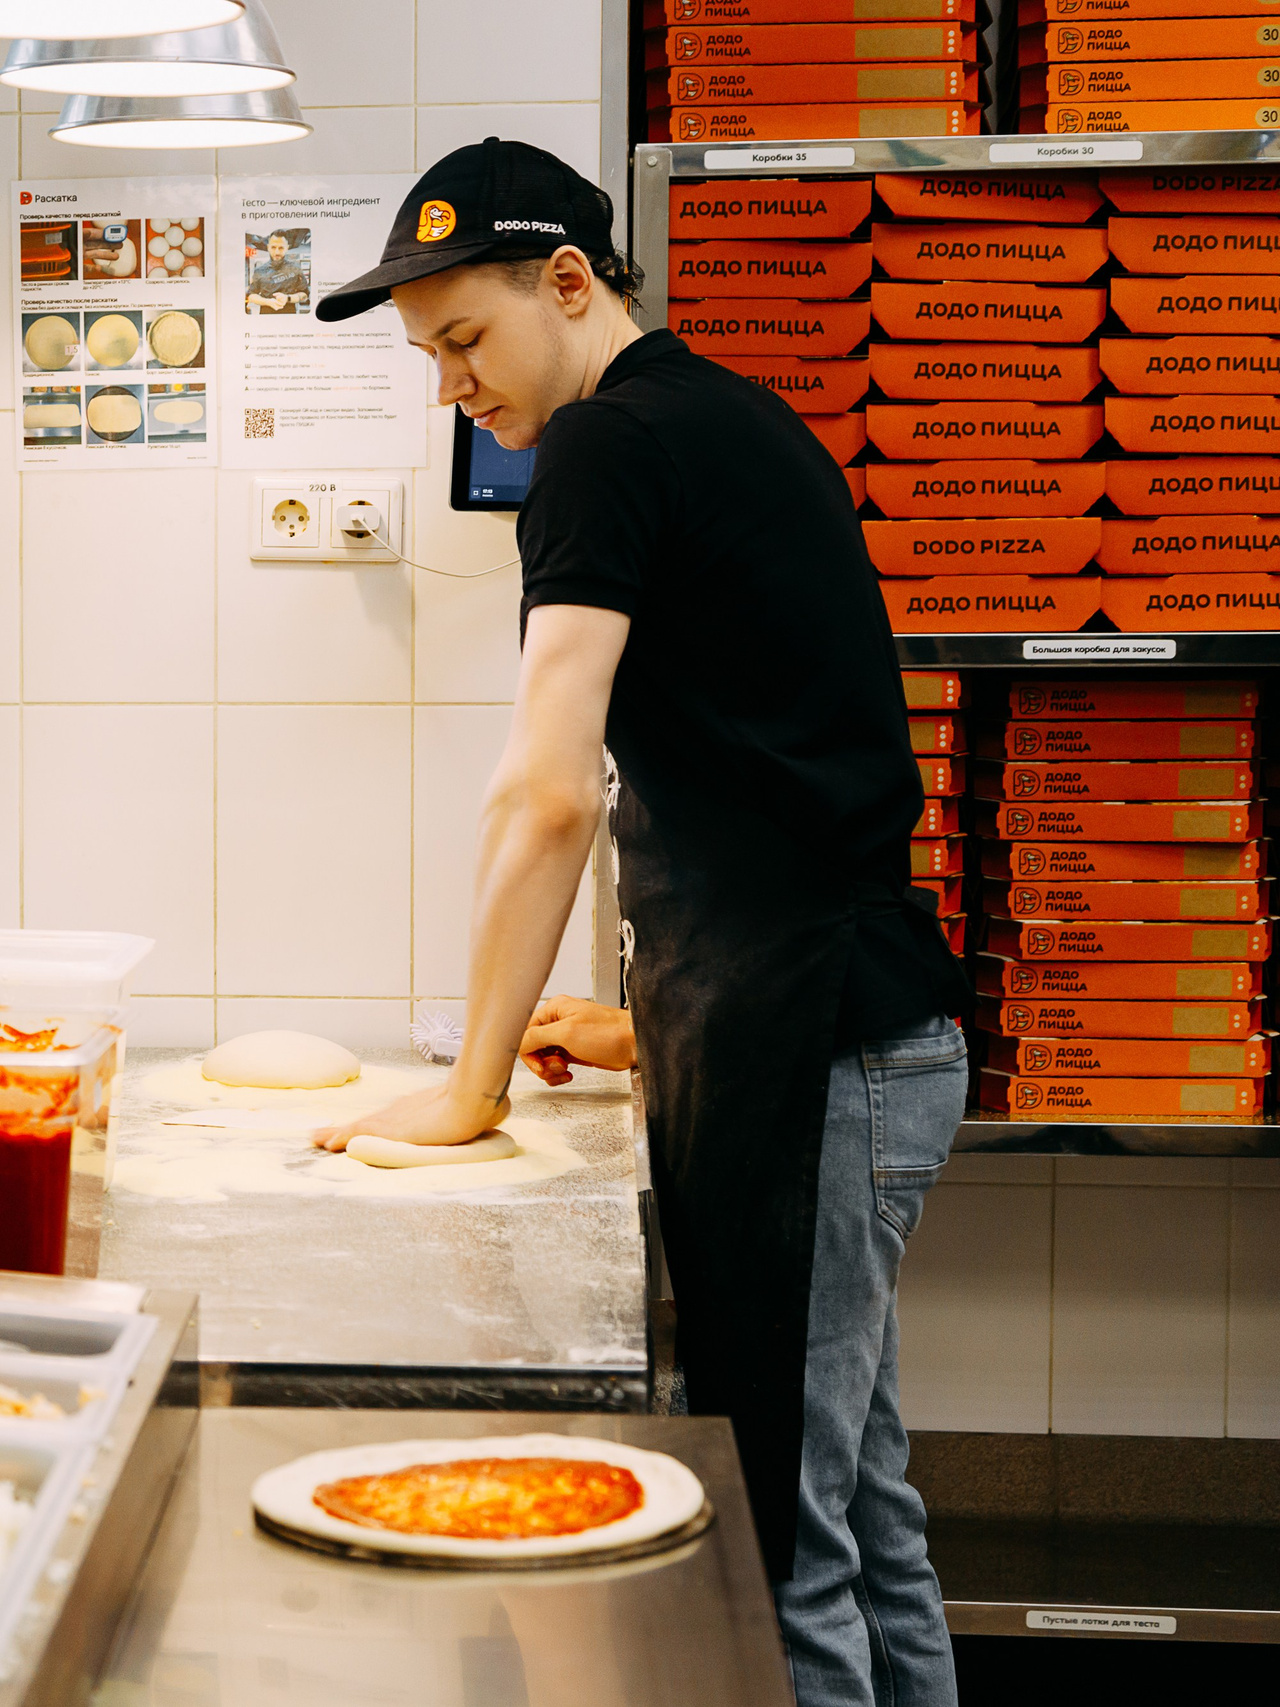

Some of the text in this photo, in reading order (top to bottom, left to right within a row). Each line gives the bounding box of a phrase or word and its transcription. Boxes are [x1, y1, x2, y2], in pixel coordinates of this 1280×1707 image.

[1087, 1, 1129, 10] ПИЦЦА
[705, 8, 750, 17] ПИЦЦА
[1088, 30, 1122, 39] ДОДО
[1263, 29, 1278, 41] 30
[707, 35, 742, 45] ДОДО
[1088, 42, 1130, 50] ПИЦЦА
[706, 48, 751, 57] ПИЦЦА
[709, 76, 745, 86] ДОДО
[1089, 72, 1123, 81] ДОДО
[1264, 70, 1279, 82] 30
[709, 88, 753, 97] ПИЦЦА
[1088, 83, 1131, 92] ПИЦЦА
[711, 115, 746, 125] ДОДО
[1087, 111, 1121, 121] ДОДО
[1262, 111, 1277, 122] 30
[710, 128, 755, 137] ПИЦЦА
[1087, 123, 1129, 132] ПИЦЦА
[1037, 147, 1094, 157] Коробки 30
[752, 153, 807, 163] Коробки 35
[1153, 176, 1215, 190] DODO
[920, 179, 1065, 200] ДОДО ПИЦЦА
[35, 194, 77, 203] Раскатка
[242, 197, 380, 207] Тесто ключевой ингредиент
[680, 200, 827, 218] ДОДО ПИЦЦА
[249, 211, 318, 220] приготовлении
[320, 210, 350, 219] пиццы
[494, 220, 566, 235] DODO PIZZA
[1153, 235, 1280, 252] ДОДО ПИЦ
[917, 242, 1065, 261] ДОДО ПИЦЦА
[679, 261, 826, 277] ДОДО ПИЦЦА
[1157, 297, 1280, 313] ДОДО ПИЦ
[916, 302, 1062, 322] ДОДО ПИЦЦА
[677, 319, 824, 337] ДОДО ПИЦЦА
[1146, 357, 1280, 374] ДОДО ПИЦЦ
[914, 363, 1061, 381] ДОДО ПИЦЦА
[1150, 416, 1215, 432] ДОДО
[913, 422, 1060, 439] ДОДО ПИЦЦА
[309, 484, 327, 492] 220
[913, 480, 1061, 497] ДОДО ПИЦЦА
[1149, 478, 1213, 495] ДОДО
[914, 539, 1045, 554] DODO PIZZA
[1132, 537, 1196, 554] ДОДО
[907, 596, 1056, 614] ДОДО ПИЦЦА
[1146, 593, 1280, 611] ДОДО ПИЦЦ
[1074, 646, 1110, 654] коробка
[1132, 647, 1166, 655] закусок
[1051, 690, 1087, 700] ДОДО
[1050, 702, 1095, 712] ПИЦЦА
[1046, 731, 1082, 741] ДОДО
[1046, 742, 1091, 752] ПИЦЦА
[1045, 773, 1081, 782] ДОДО
[1044, 784, 1090, 794] ПИЦЦА
[1038, 812, 1075, 822] ДОДО
[1038, 824, 1083, 834] ПИЦЦА
[1050, 852, 1086, 861] ДОДО
[1050, 863, 1095, 873] ПИЦЦА
[1046, 891, 1082, 901] ДОДО
[1046, 902, 1091, 912] ПИЦЦА
[1059, 932, 1095, 941] ДОДО
[1059, 943, 1103, 953] ПИЦЦА
[1043, 970, 1079, 980] ДОДО
[1042, 982, 1087, 992] ПИЦЦА
[1039, 1009, 1075, 1018] ДОДО
[1039, 1020, 1083, 1030] ПИЦЦА
[1056, 1048, 1092, 1057] ДОДО
[1056, 1059, 1101, 1069] ПИЦЦА
[1048, 1087, 1084, 1096] ДОДО
[1047, 1097, 1092, 1107] ПИЦЦА
[1042, 1616, 1078, 1625] Пустые
[1081, 1618, 1109, 1626] лотки
